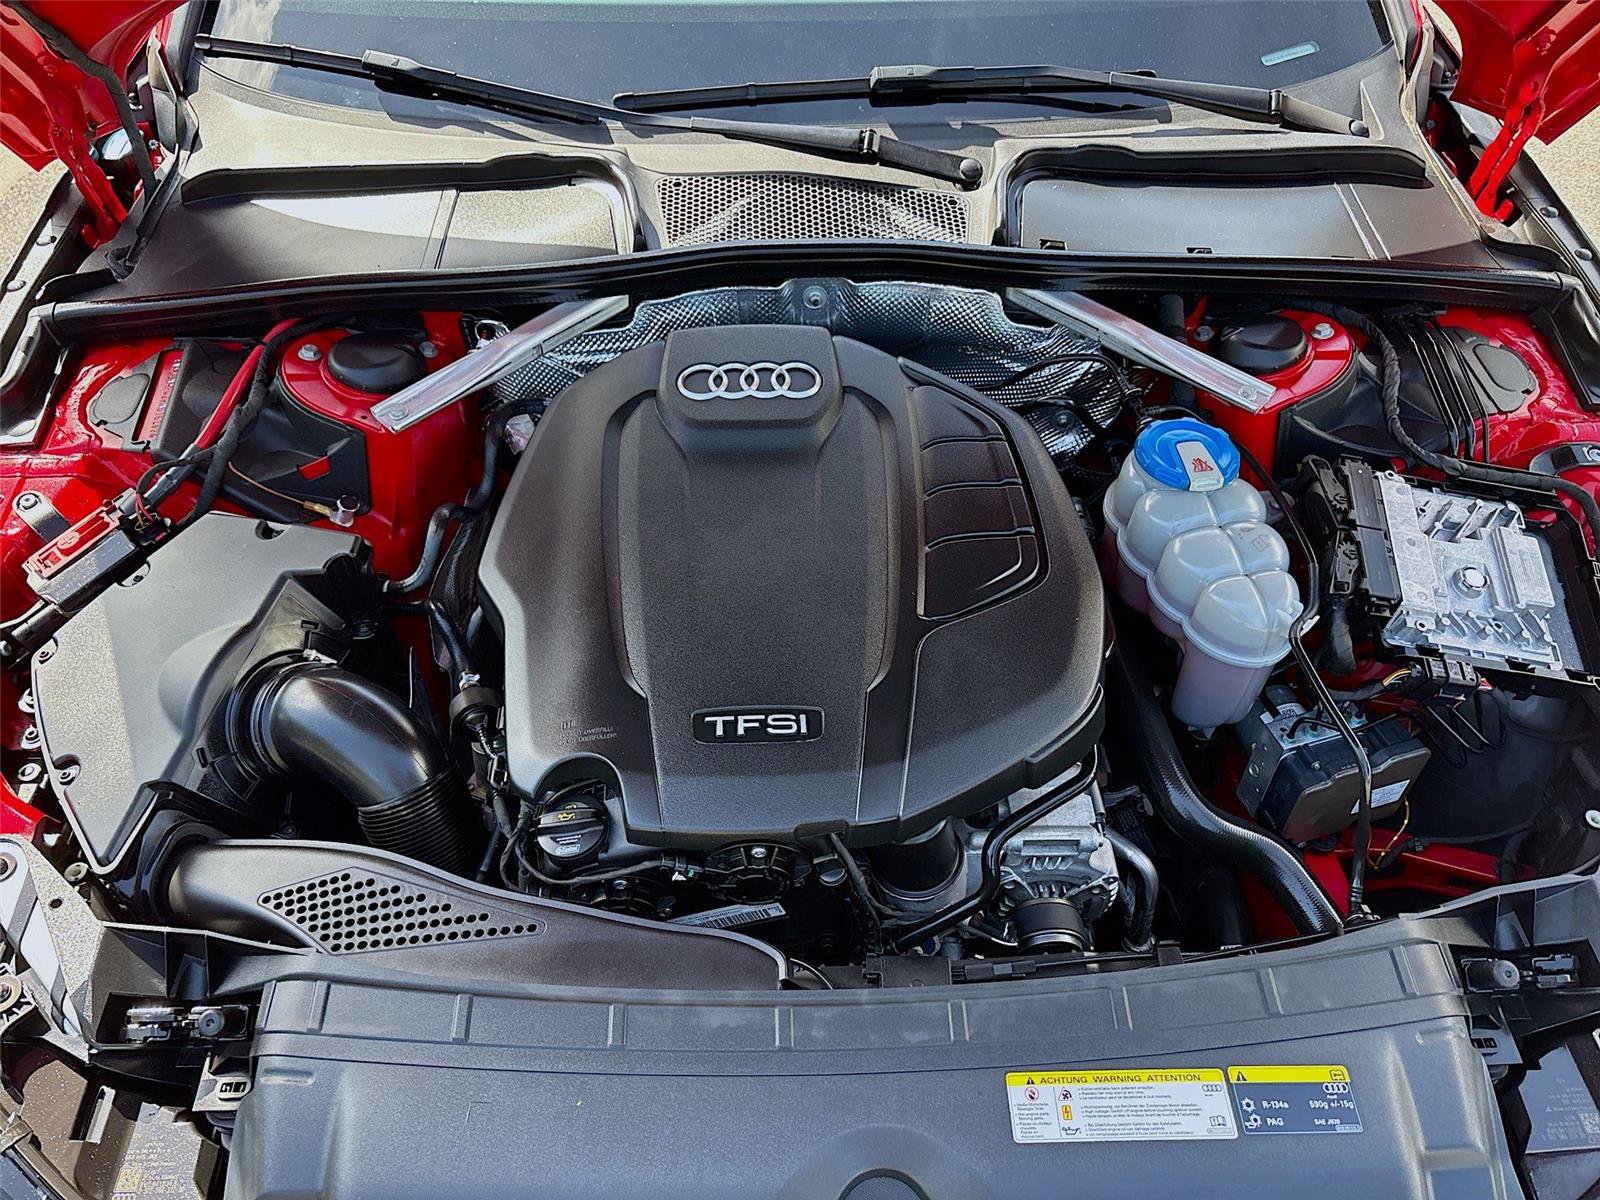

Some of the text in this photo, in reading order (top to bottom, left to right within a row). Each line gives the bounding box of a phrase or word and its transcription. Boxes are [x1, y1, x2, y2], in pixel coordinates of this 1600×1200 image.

[704, 714, 807, 736] TFSI
[1040, 1073, 1201, 1084] ACHTUNG WARNING ATTENTION
[1262, 1100, 1289, 1109] R-134a
[1266, 1118, 1285, 1126] PAG
